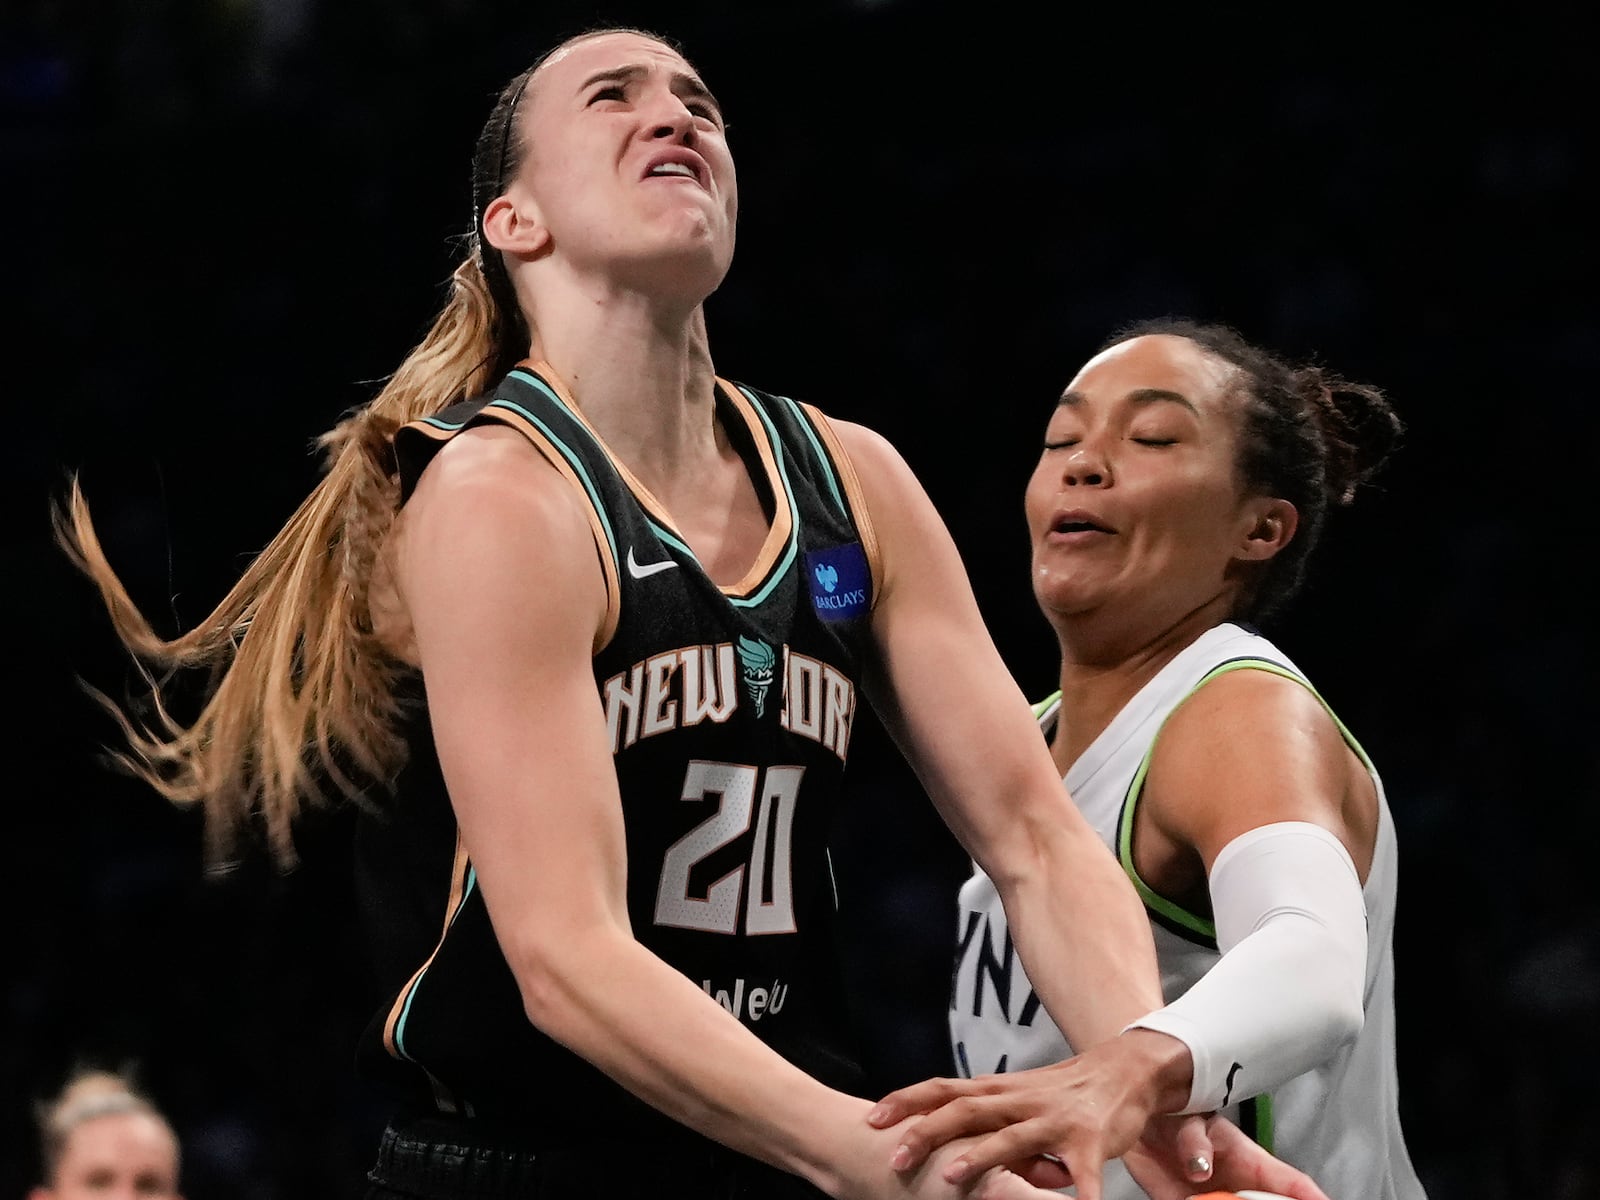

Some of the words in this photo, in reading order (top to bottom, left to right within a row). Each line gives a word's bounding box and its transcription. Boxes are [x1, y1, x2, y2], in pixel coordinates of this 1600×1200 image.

[605, 642, 738, 754] NEW
[781, 643, 856, 765] OR
[654, 760, 806, 936] 20
